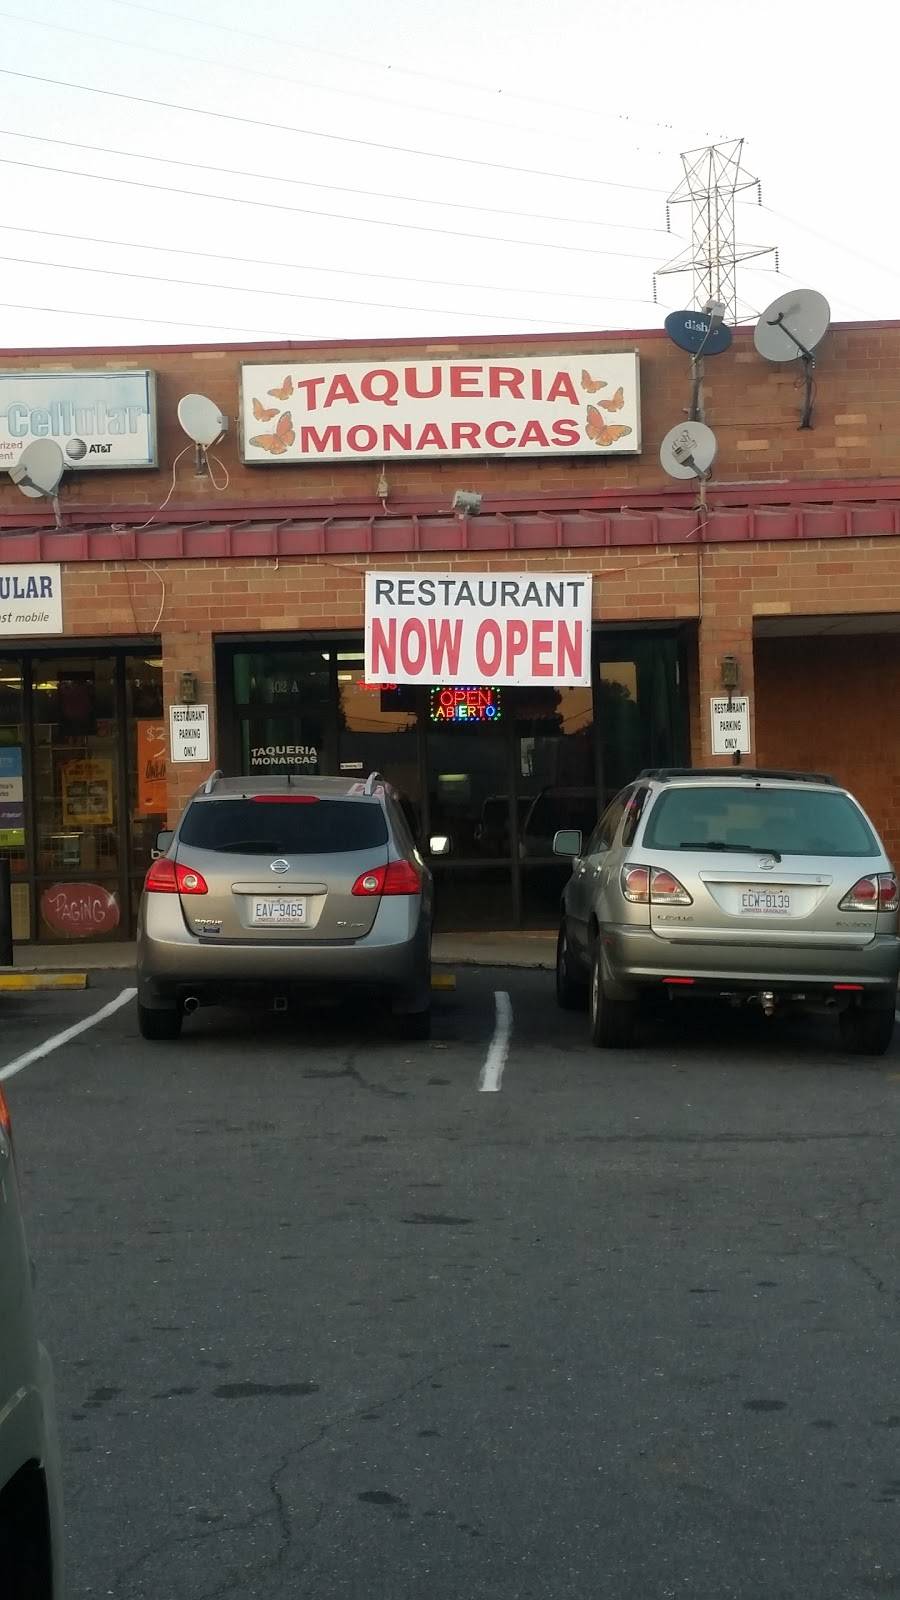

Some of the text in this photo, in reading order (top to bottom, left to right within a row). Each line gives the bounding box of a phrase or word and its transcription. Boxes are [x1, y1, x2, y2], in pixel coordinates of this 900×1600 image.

[298, 366, 580, 411] TAQUERIA
[7, 401, 143, 438] Cellular
[301, 419, 581, 453] MONARCAS
[89, 443, 113, 454] AT&T
[0, 576, 53, 599] ULAR
[375, 579, 585, 608] RESTAURANT
[0, 611, 49, 623] st mobile
[371, 617, 582, 677] NOW OPEN
[440, 690, 491, 706] OPEN
[436, 705, 496, 717] ABIERTO
[719, 720, 742, 731] PARKING
[179, 728, 201, 739] PARKING
[725, 738, 738, 749] ONLY
[184, 746, 197, 757] ONLY
[251, 745, 318, 757] TAQUERIA
[251, 756, 318, 766] MONARCAS
[742, 893, 790, 908] ECW-8139
[256, 903, 303, 917] EAV-9465
